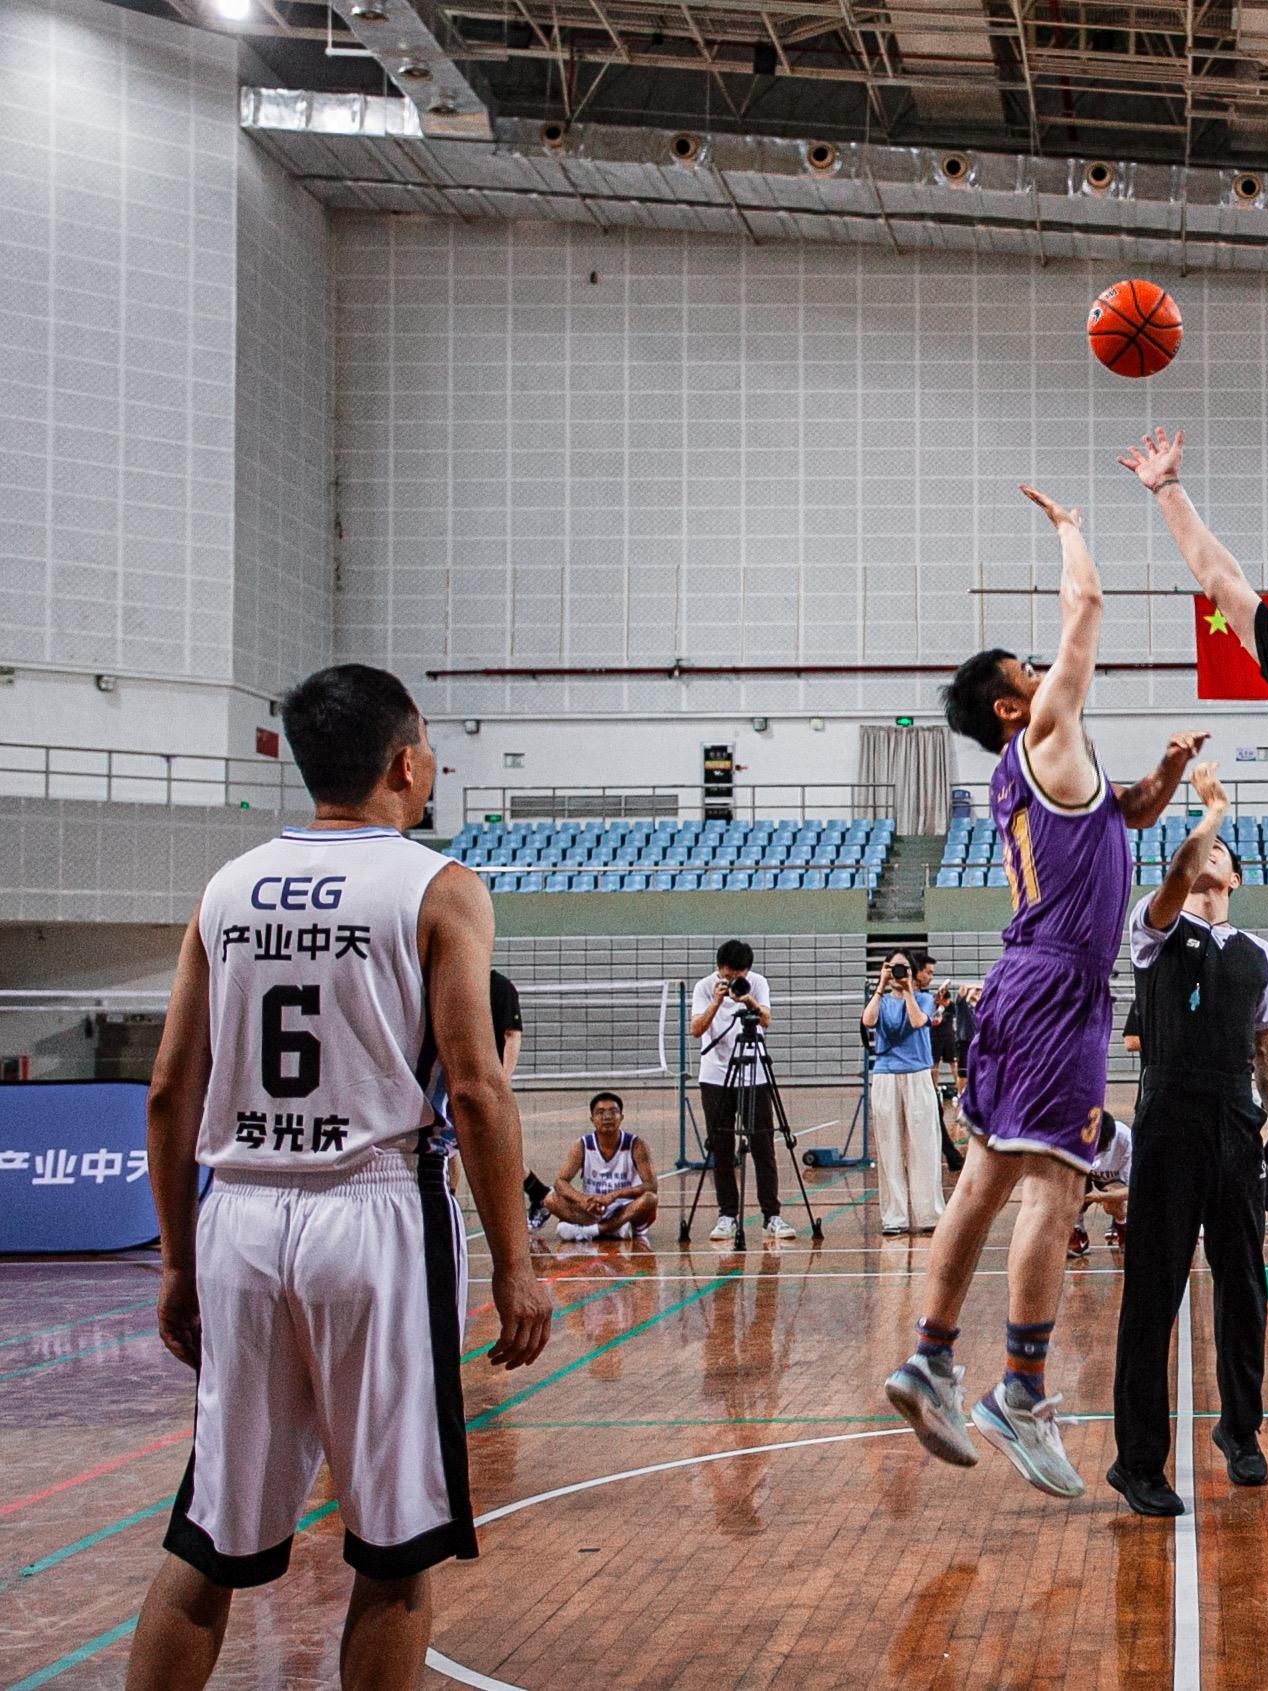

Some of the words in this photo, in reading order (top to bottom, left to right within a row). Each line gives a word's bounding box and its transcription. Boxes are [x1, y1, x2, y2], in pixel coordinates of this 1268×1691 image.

[251, 876, 346, 911] CEG
[222, 923, 371, 963] 产业中天
[262, 984, 321, 1099] 6
[236, 1111, 350, 1153] 岑光庆
[1081, 1106, 1101, 1144] 3
